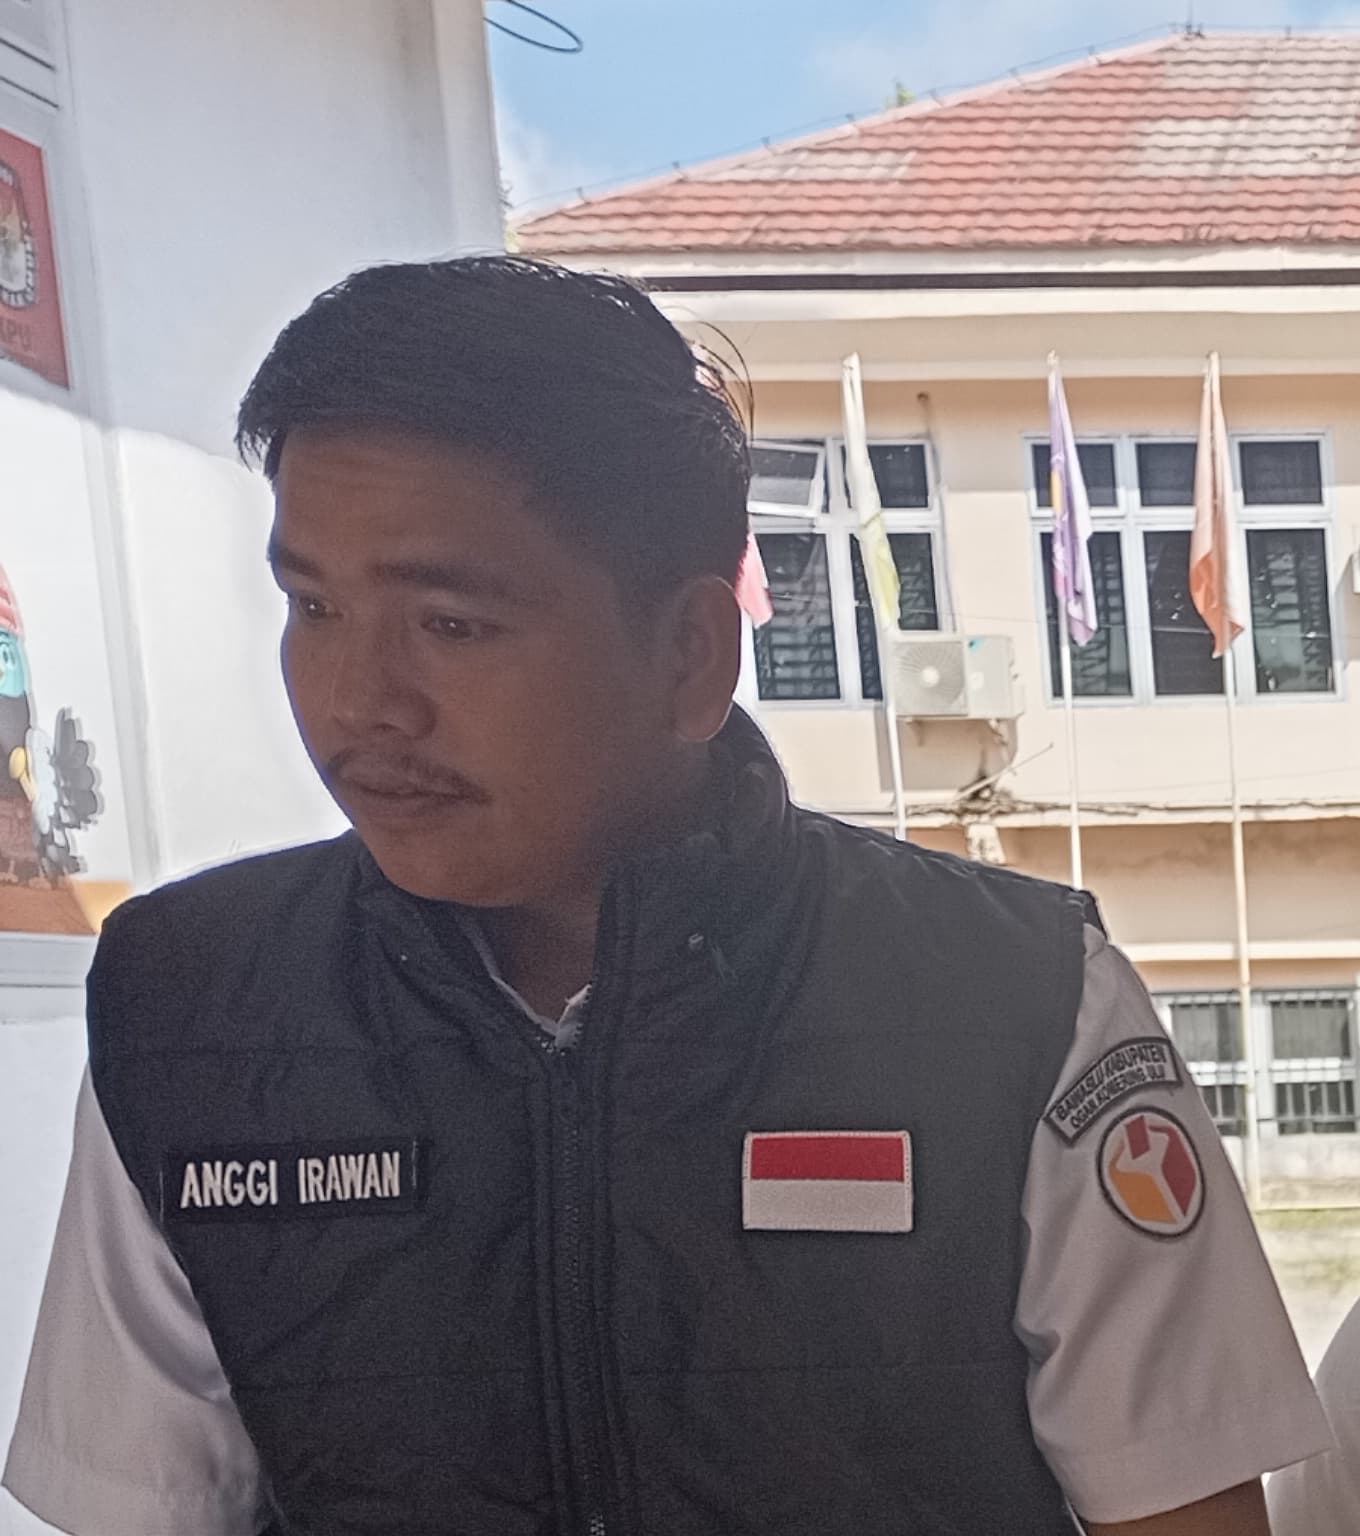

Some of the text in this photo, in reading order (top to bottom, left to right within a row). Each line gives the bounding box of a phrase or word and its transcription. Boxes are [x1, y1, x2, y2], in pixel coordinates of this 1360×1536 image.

[1056, 1043, 1167, 1121] BAWASLU KABUPATEN
[1070, 1099, 1097, 1129] OGAN
[1145, 1064, 1166, 1080] ULU
[180, 1151, 400, 1208] ANGGI IRAWAN
